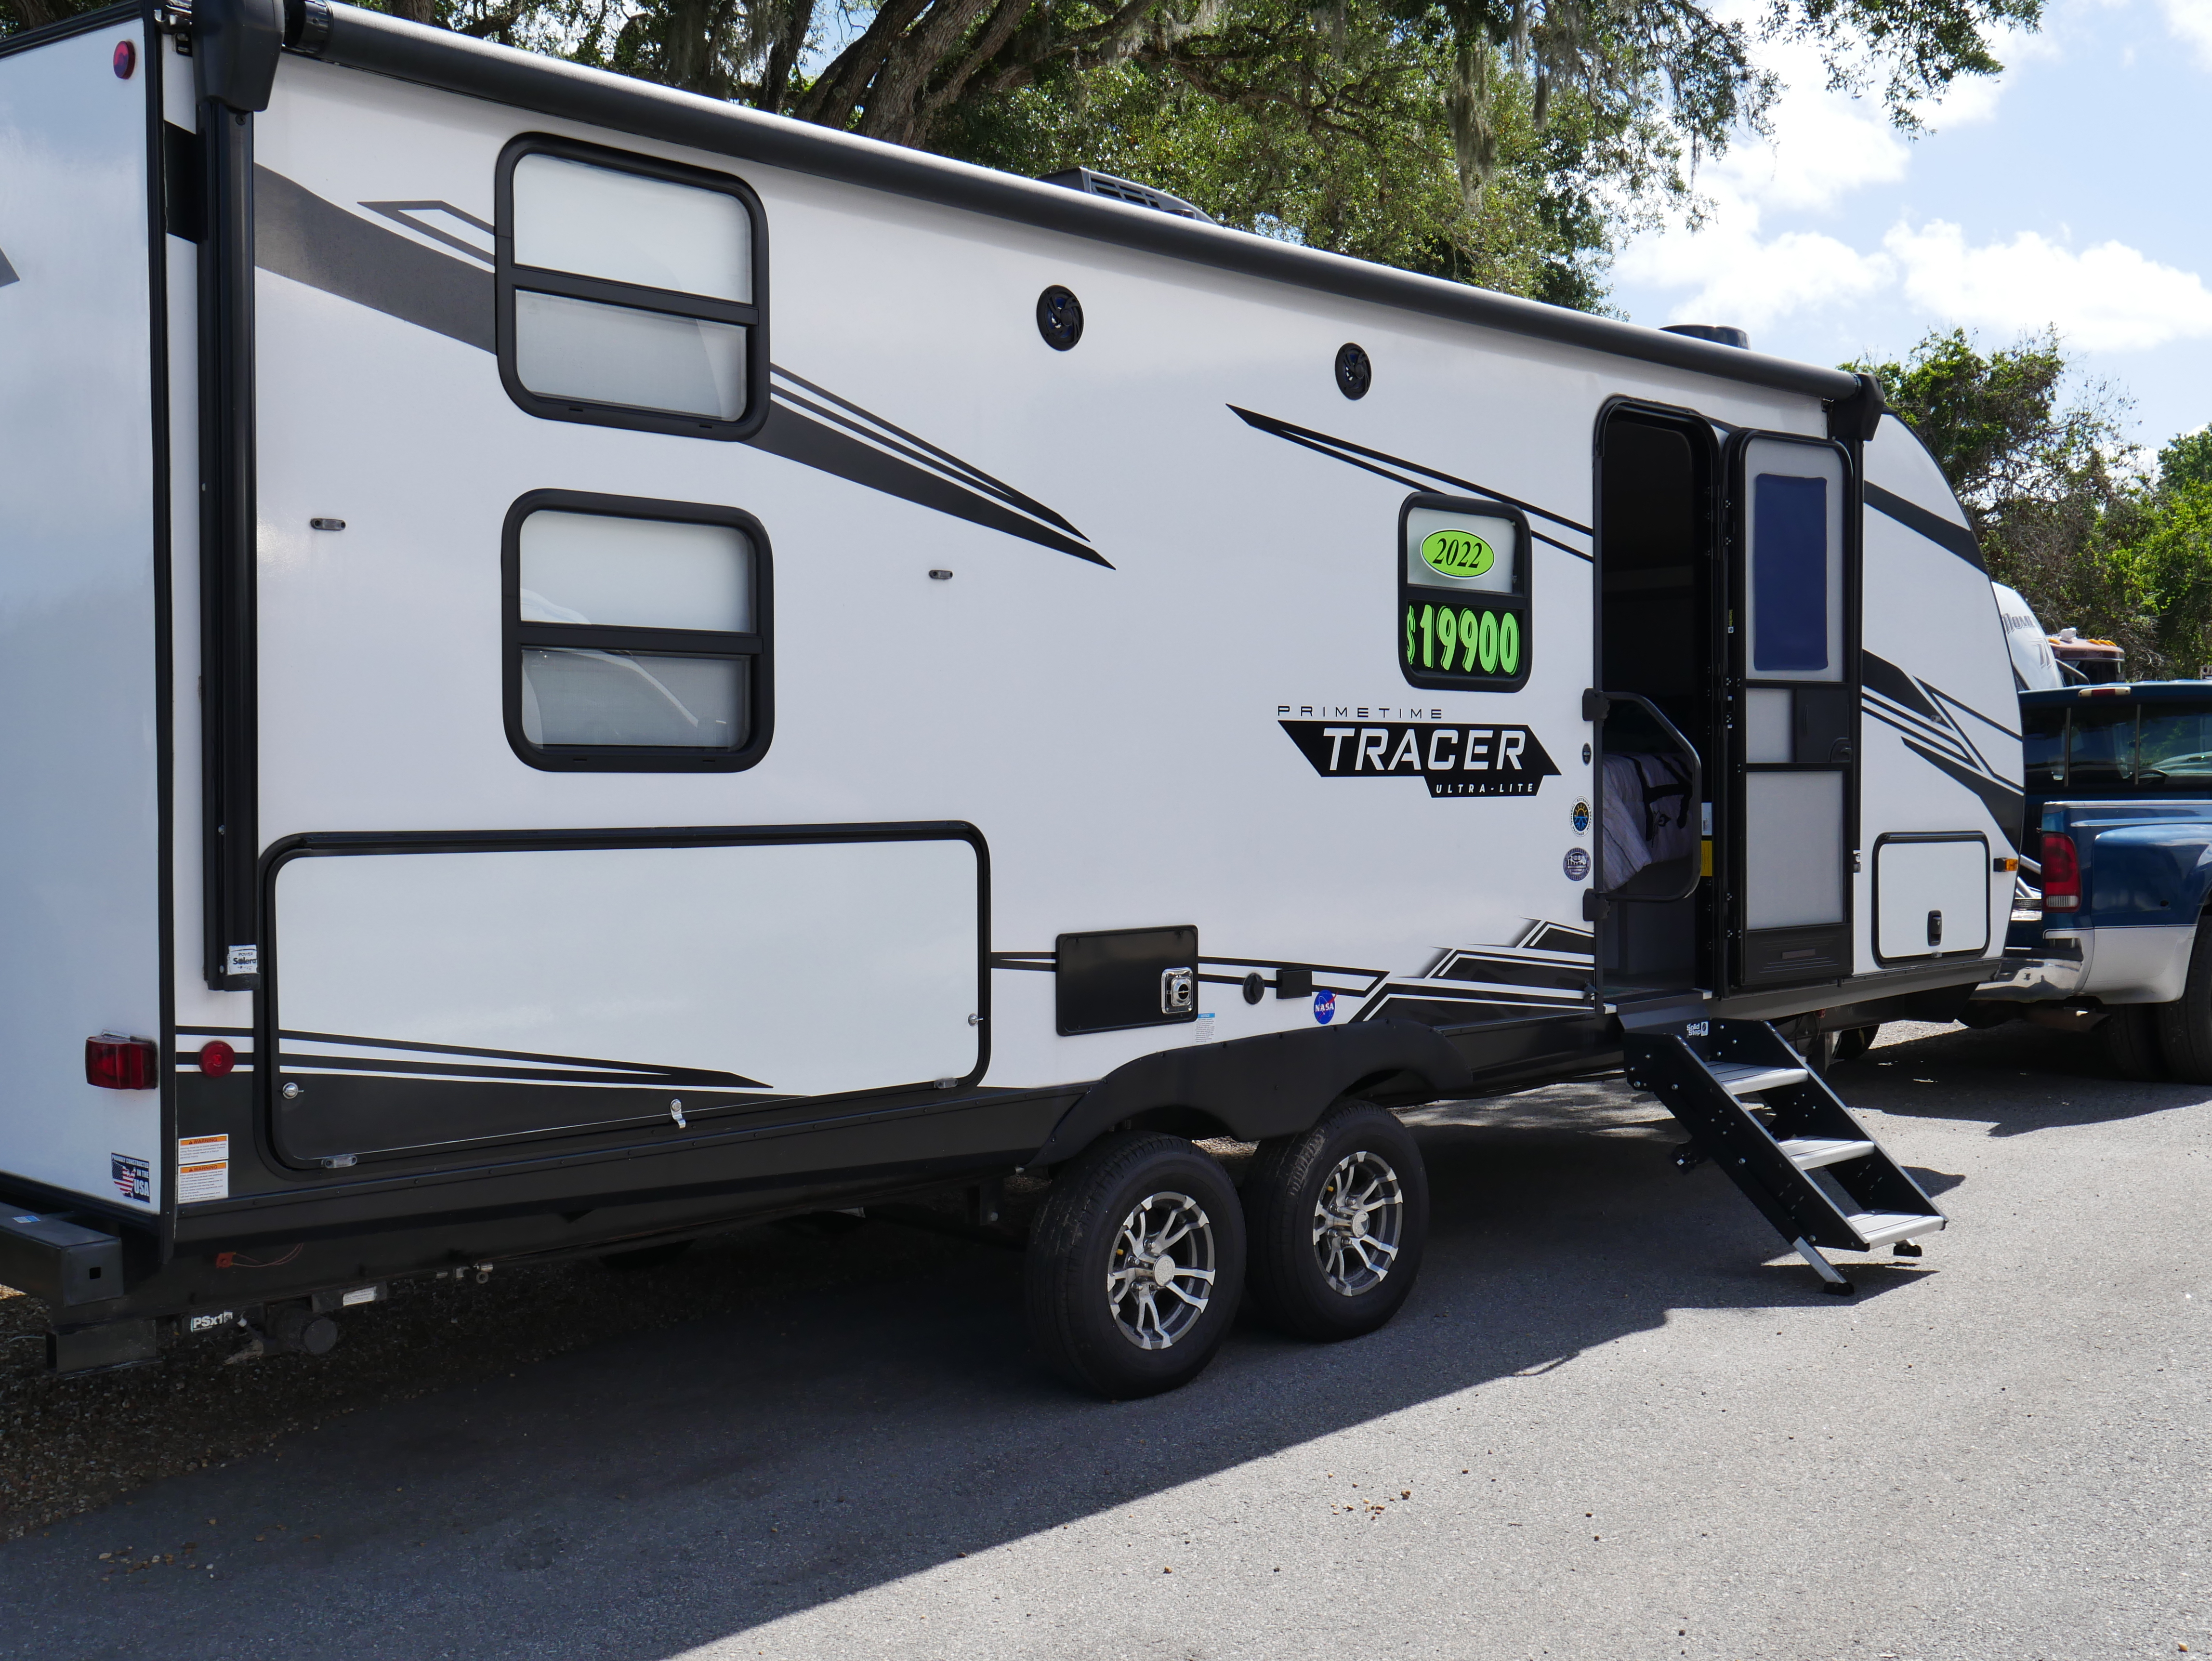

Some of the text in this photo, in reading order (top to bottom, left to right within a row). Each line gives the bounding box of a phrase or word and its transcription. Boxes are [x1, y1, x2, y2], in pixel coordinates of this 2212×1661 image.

[1432, 538, 1482, 568] 2022
[1407, 604, 1520, 675] $19900
[1277, 705, 1442, 719] PRIMETIME
[1323, 728, 1526, 770] TRACER
[1315, 1002, 1334, 1012] NASA
[1686, 1023, 1700, 1031] Solid
[134, 1178, 150, 1197] USA
